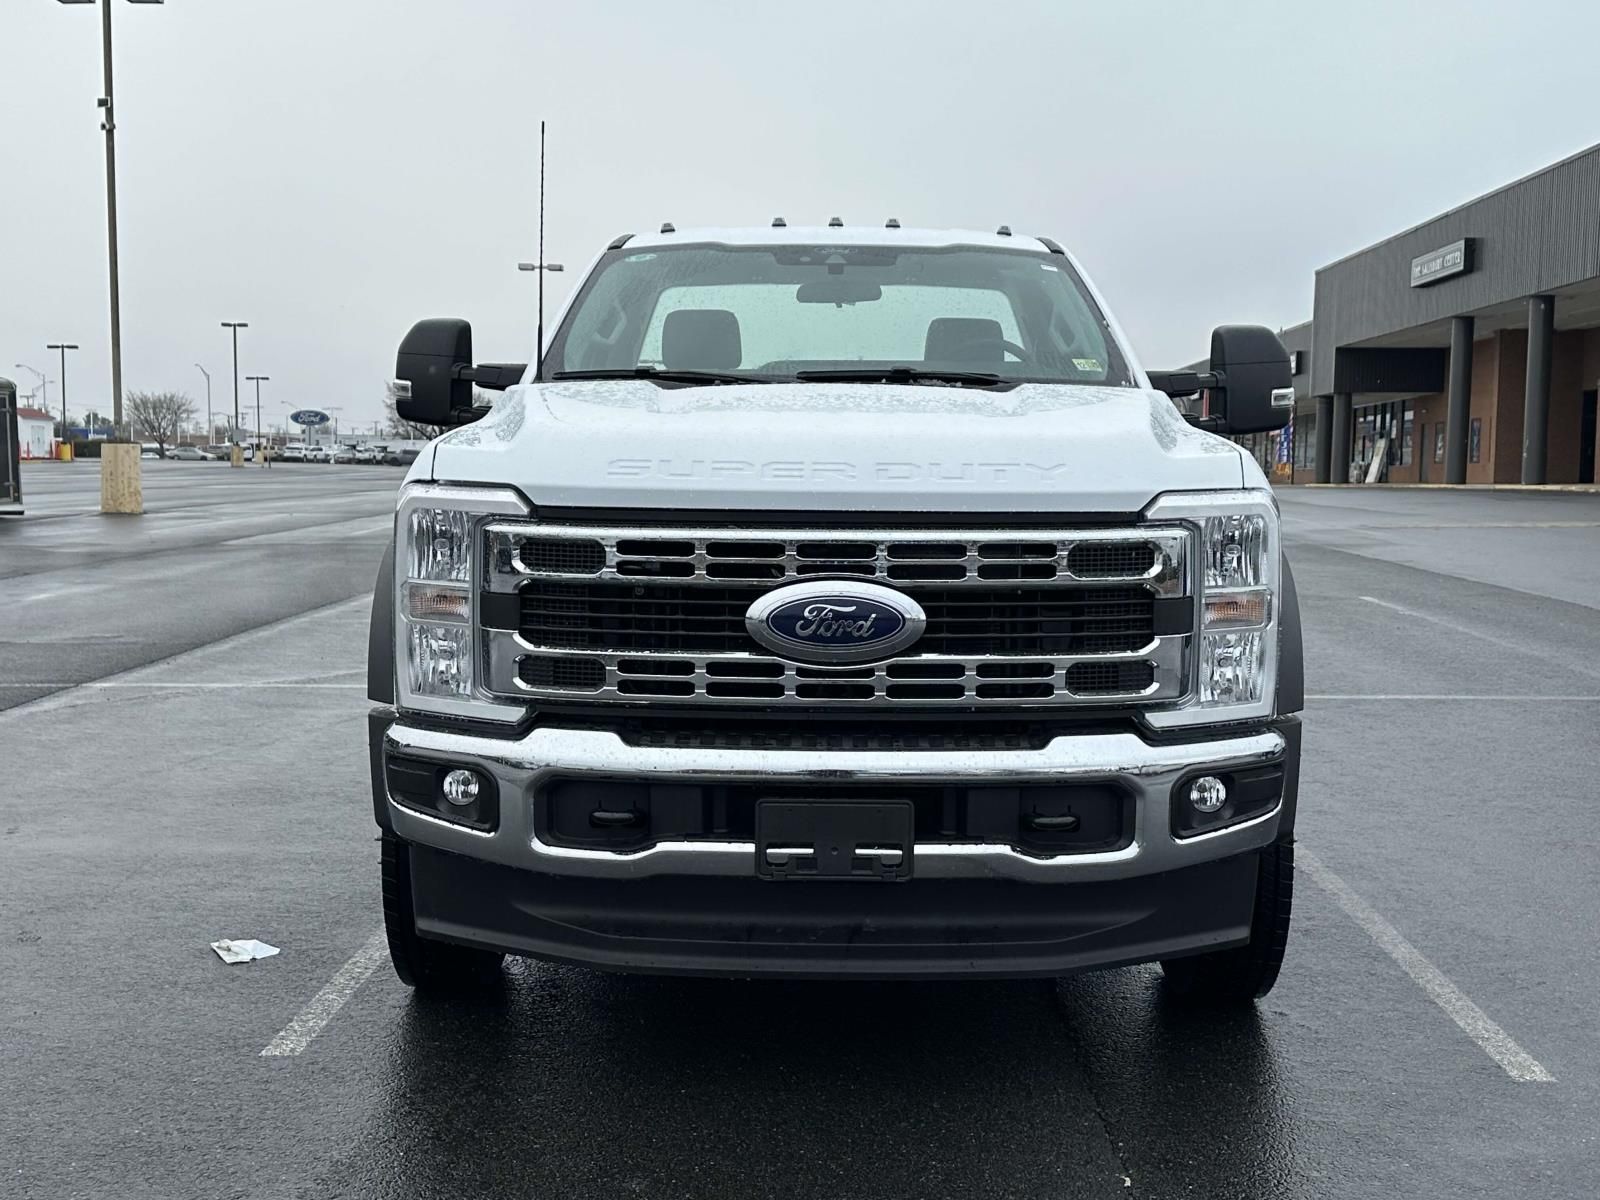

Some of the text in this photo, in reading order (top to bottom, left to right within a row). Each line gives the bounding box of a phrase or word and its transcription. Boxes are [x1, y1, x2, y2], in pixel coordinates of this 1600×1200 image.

[298, 412, 321, 422] Ford
[607, 458, 1067, 484] SUPER DUTY
[795, 603, 877, 637] Ford
